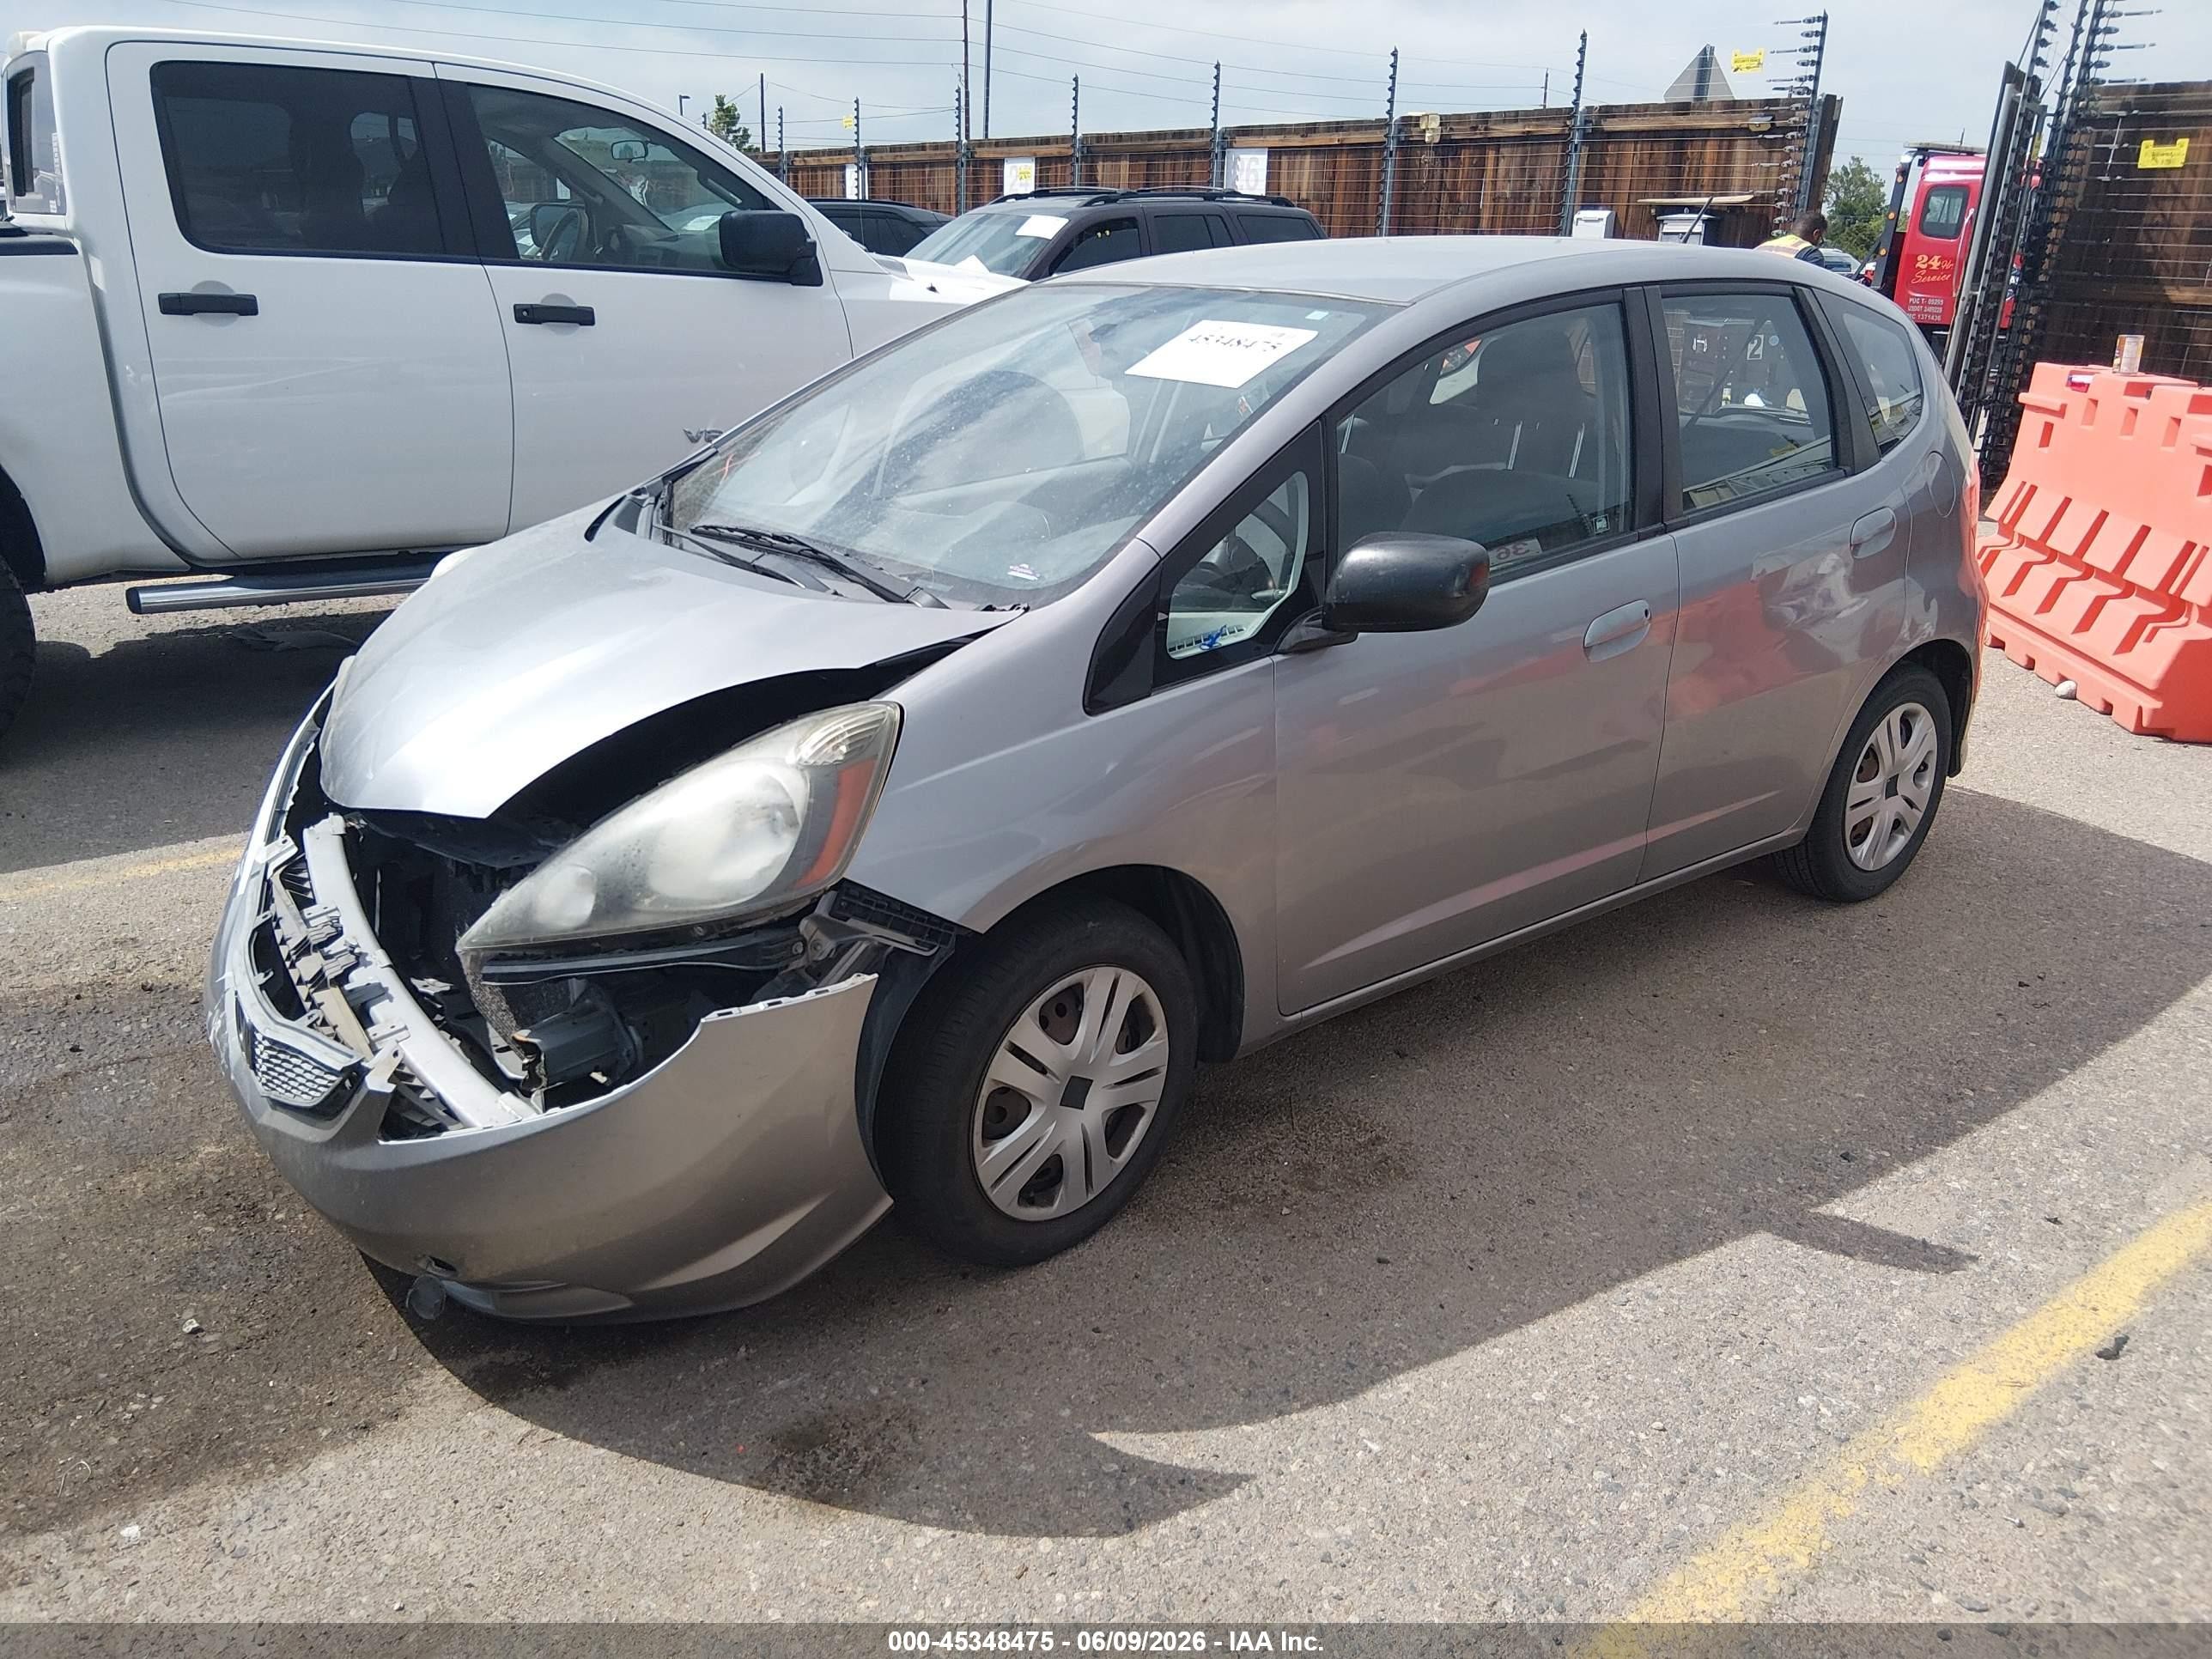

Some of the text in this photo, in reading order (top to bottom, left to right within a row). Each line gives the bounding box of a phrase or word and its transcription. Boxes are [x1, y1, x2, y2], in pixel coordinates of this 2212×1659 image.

[1915, 254, 1942, 270] 24
[1911, 270, 1952, 284] Service
[1748, 335, 1762, 359] 2
